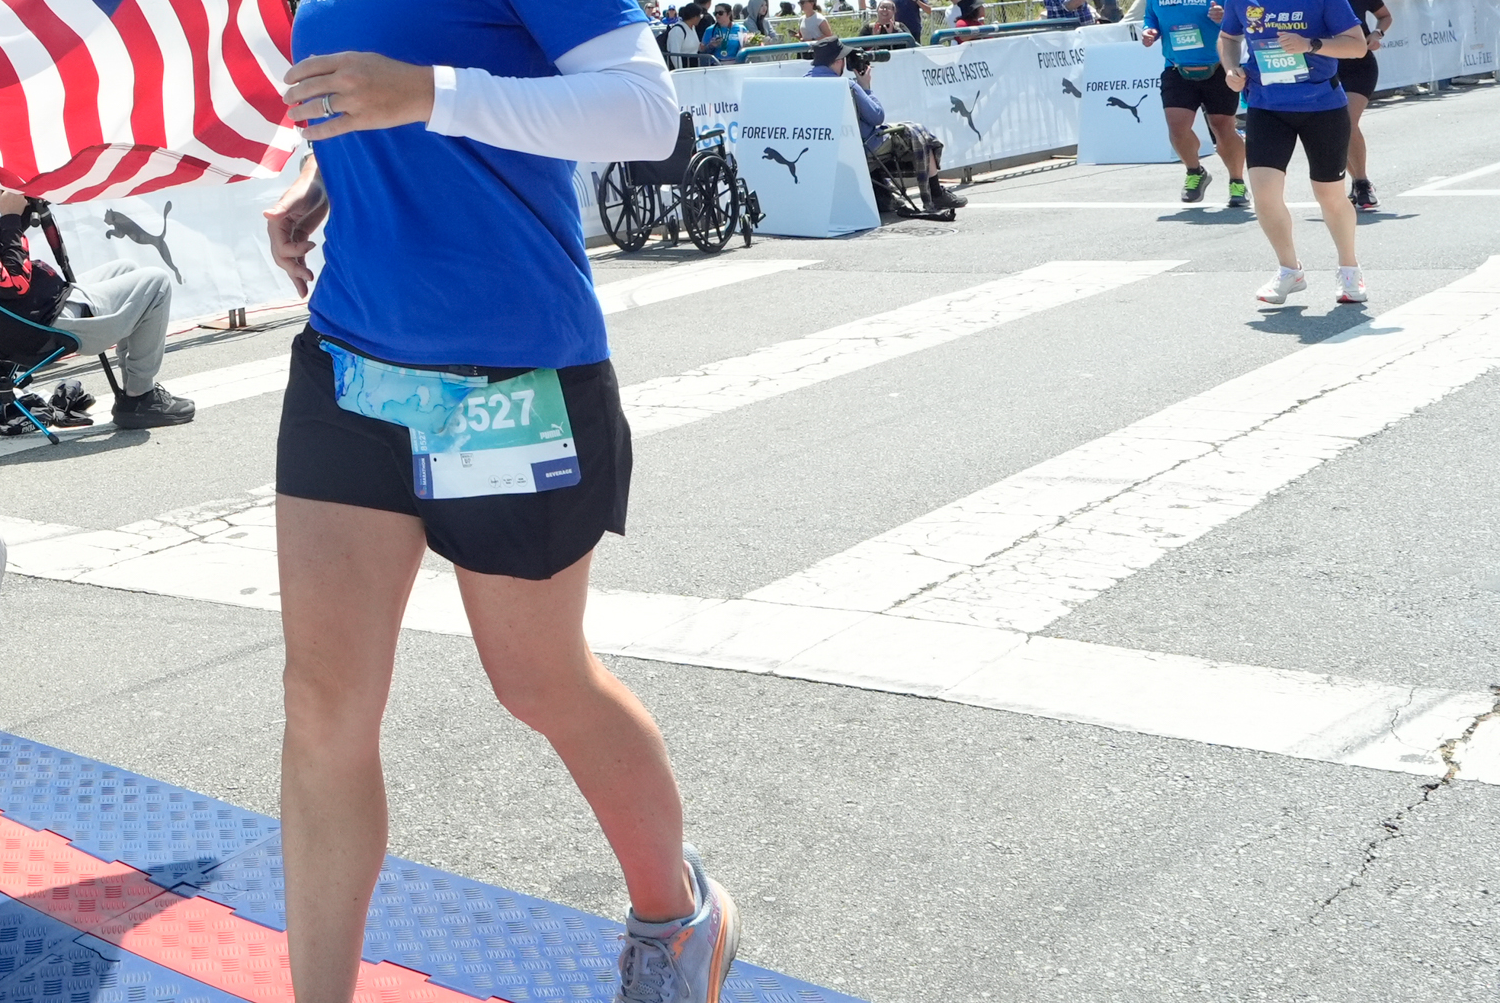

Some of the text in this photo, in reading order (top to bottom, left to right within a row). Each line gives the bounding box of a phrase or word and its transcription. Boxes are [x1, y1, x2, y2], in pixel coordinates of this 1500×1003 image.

[1420, 30, 1458, 47] GARMIN
[1037, 50, 1071, 69] FOREVER.
[1264, 56, 1297, 69] 7608
[922, 61, 994, 87] FOREVER. FASTER.
[1086, 80, 1130, 92] FOREVER.
[690, 105, 708, 117] Full
[713, 102, 739, 115] Ultra
[742, 126, 835, 141] FOREVER. FASTER.
[545, 468, 573, 479] BEVERAGE
